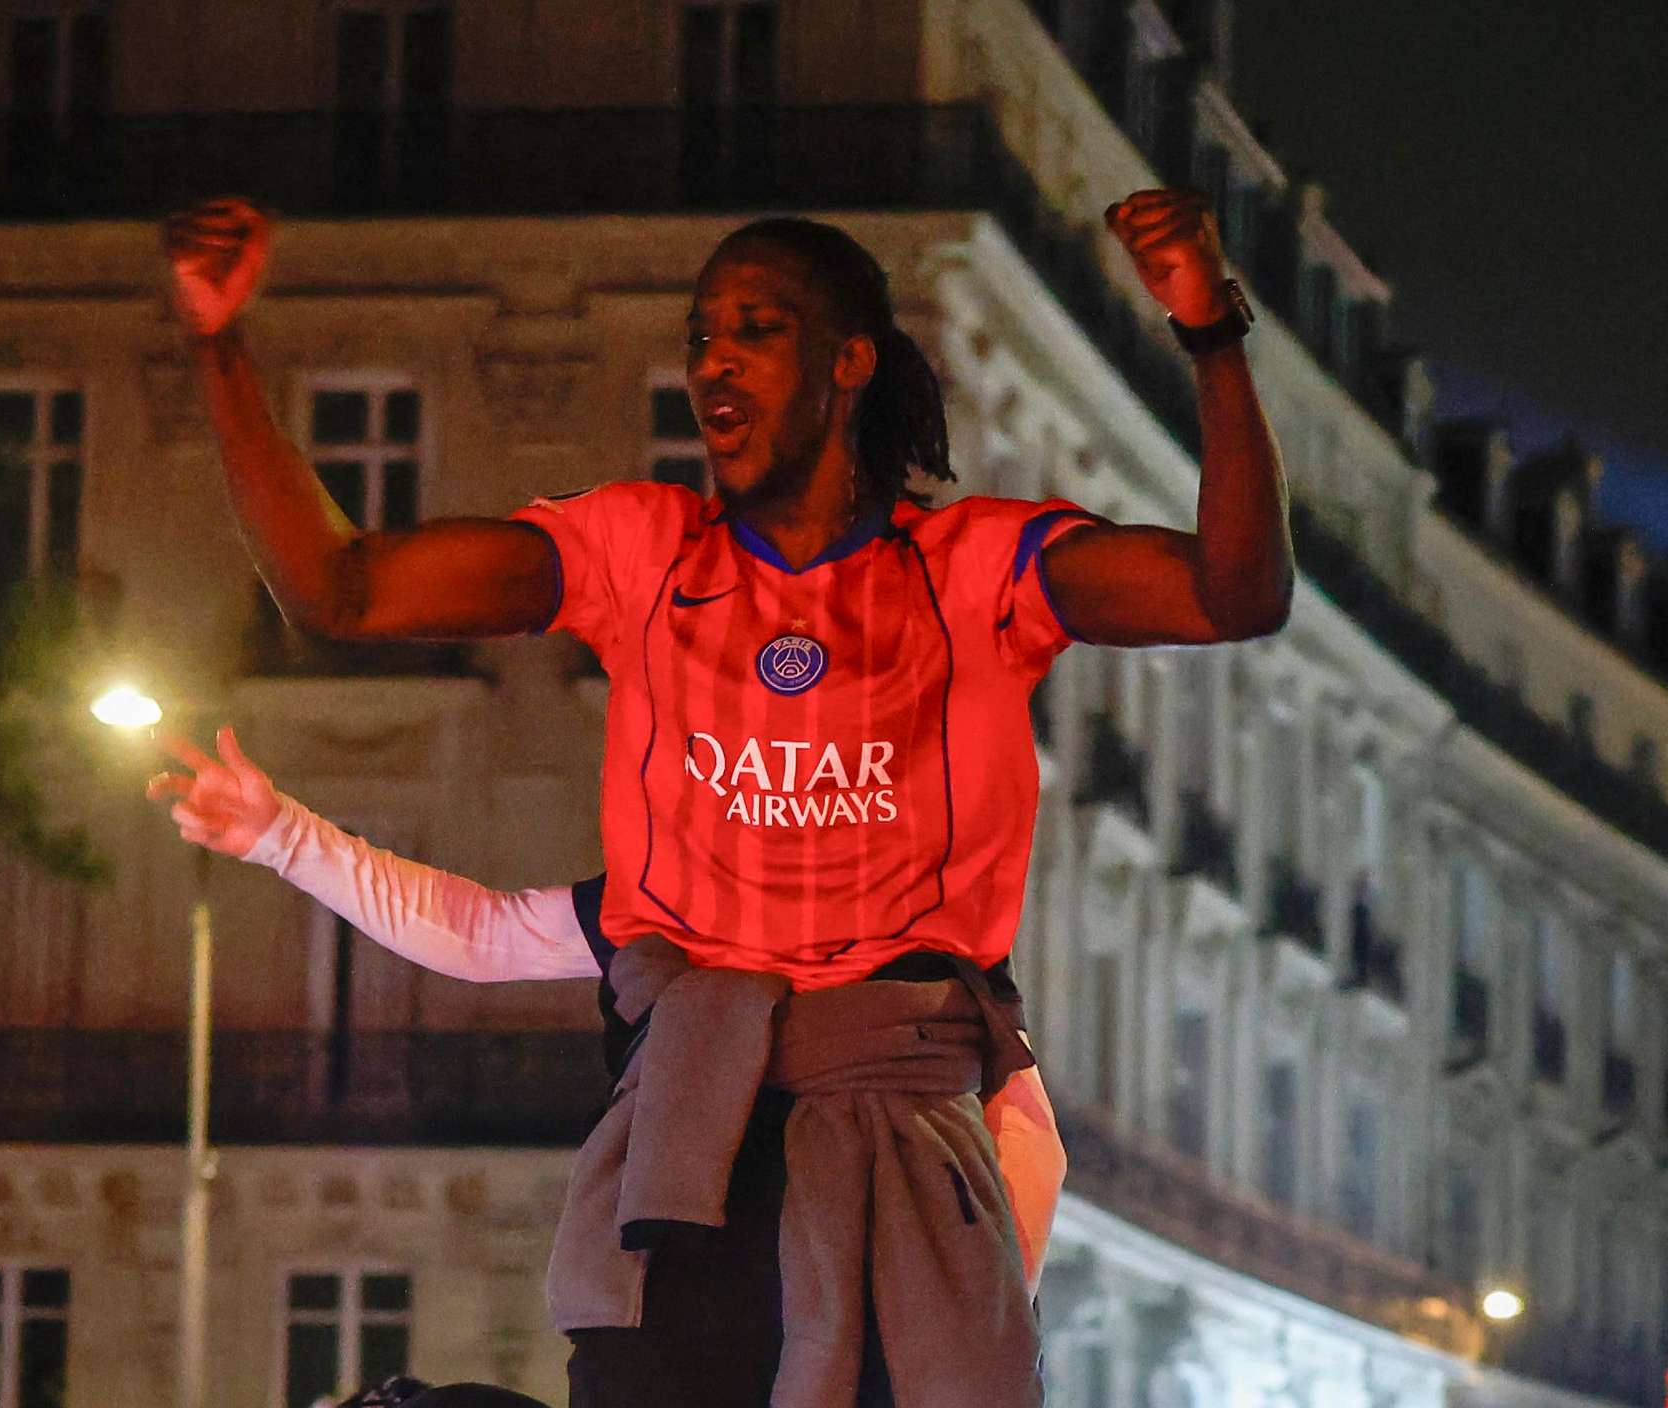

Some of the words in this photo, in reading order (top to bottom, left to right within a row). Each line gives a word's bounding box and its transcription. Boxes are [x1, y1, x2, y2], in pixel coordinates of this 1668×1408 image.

[773, 638, 813, 651] PARIS
[685, 732, 895, 796] QATAR
[726, 789, 897, 828] AIRWAYS
